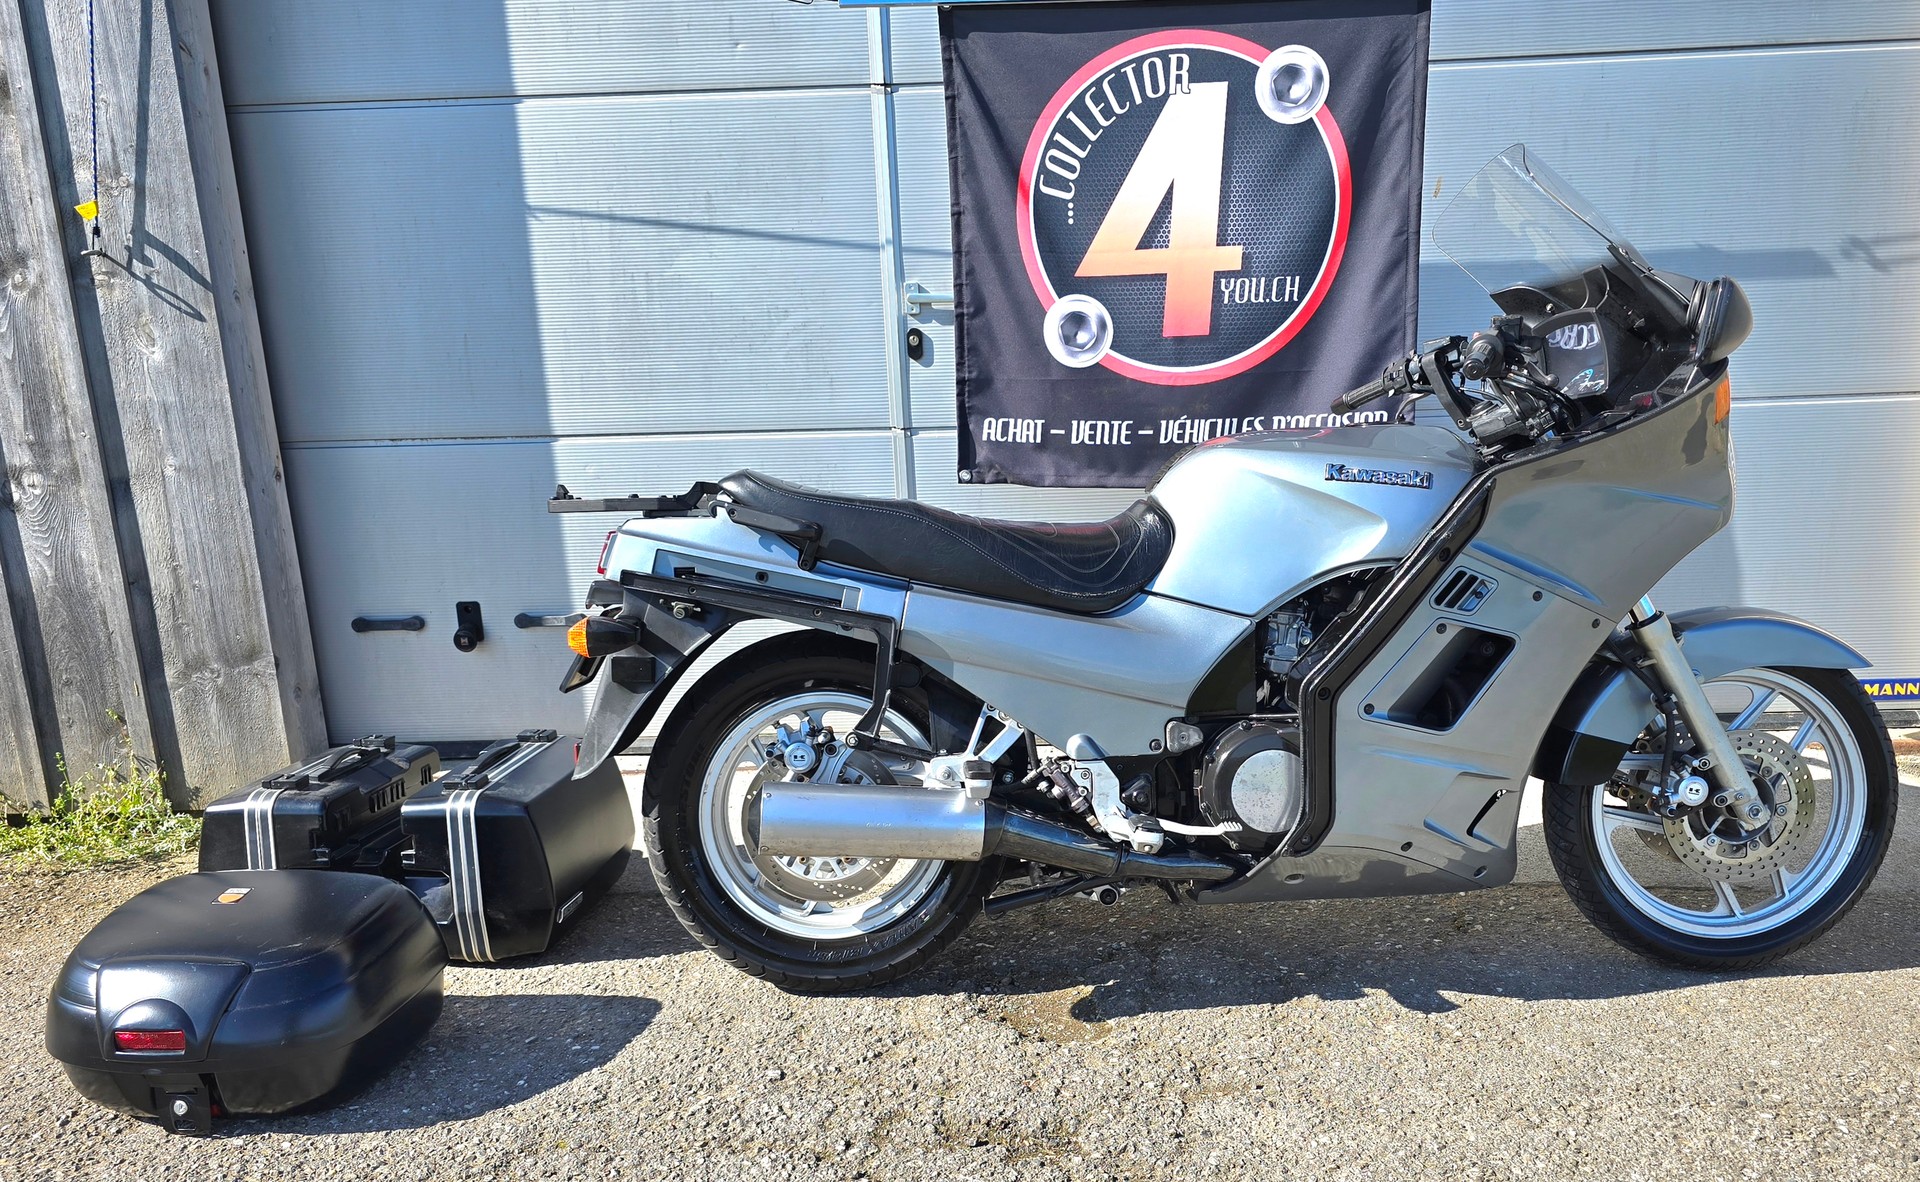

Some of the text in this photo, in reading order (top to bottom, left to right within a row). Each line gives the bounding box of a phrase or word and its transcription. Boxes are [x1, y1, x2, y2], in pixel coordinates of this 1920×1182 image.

[1074, 81, 1243, 338] 4
[1220, 276, 1300, 305] YOU.CH
[982, 417, 1046, 444] ACHAT
[1070, 419, 1134, 445] VENTE
[1325, 463, 1433, 490] Kawasaki
